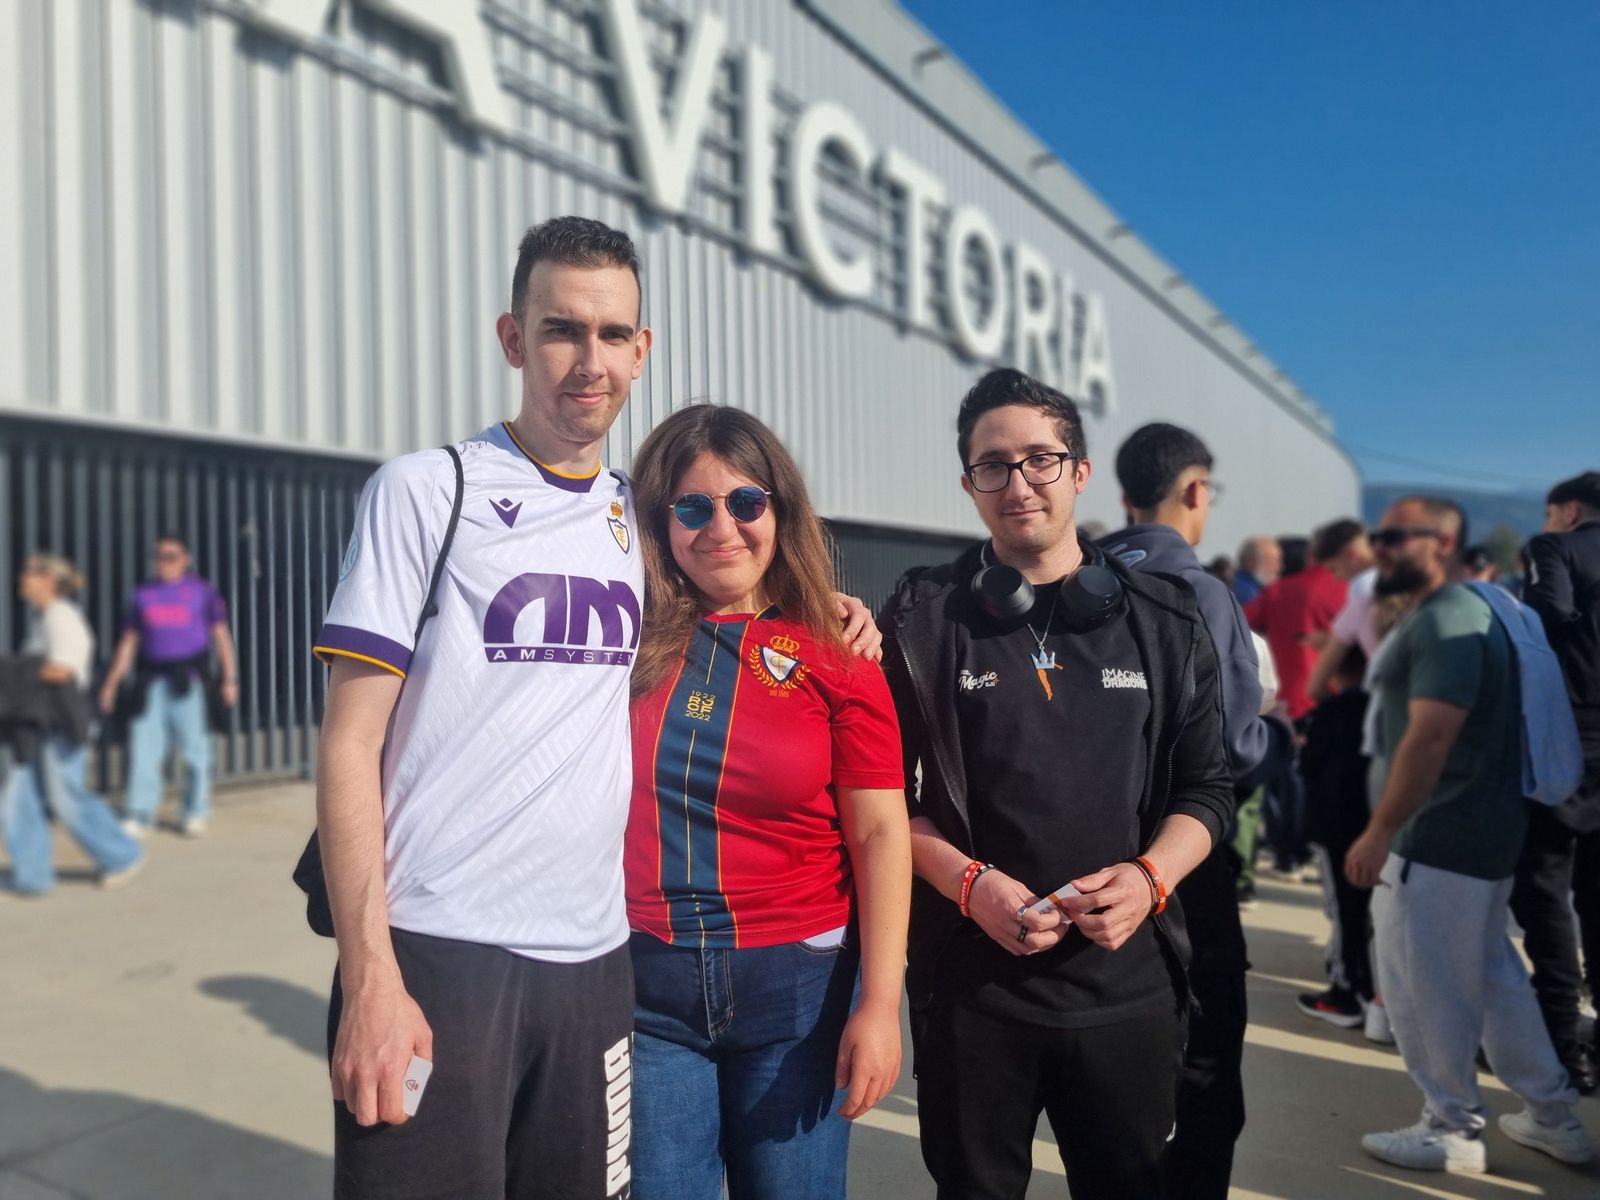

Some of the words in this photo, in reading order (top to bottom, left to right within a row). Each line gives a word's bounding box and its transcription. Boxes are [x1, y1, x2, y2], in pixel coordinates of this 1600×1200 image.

[605, 0, 1120, 414] VICTORIA
[493, 649, 632, 664] AMSYST
[959, 671, 997, 692] Magic
[685, 710, 711, 722] 2022
[604, 1036, 631, 1197] PUMA
